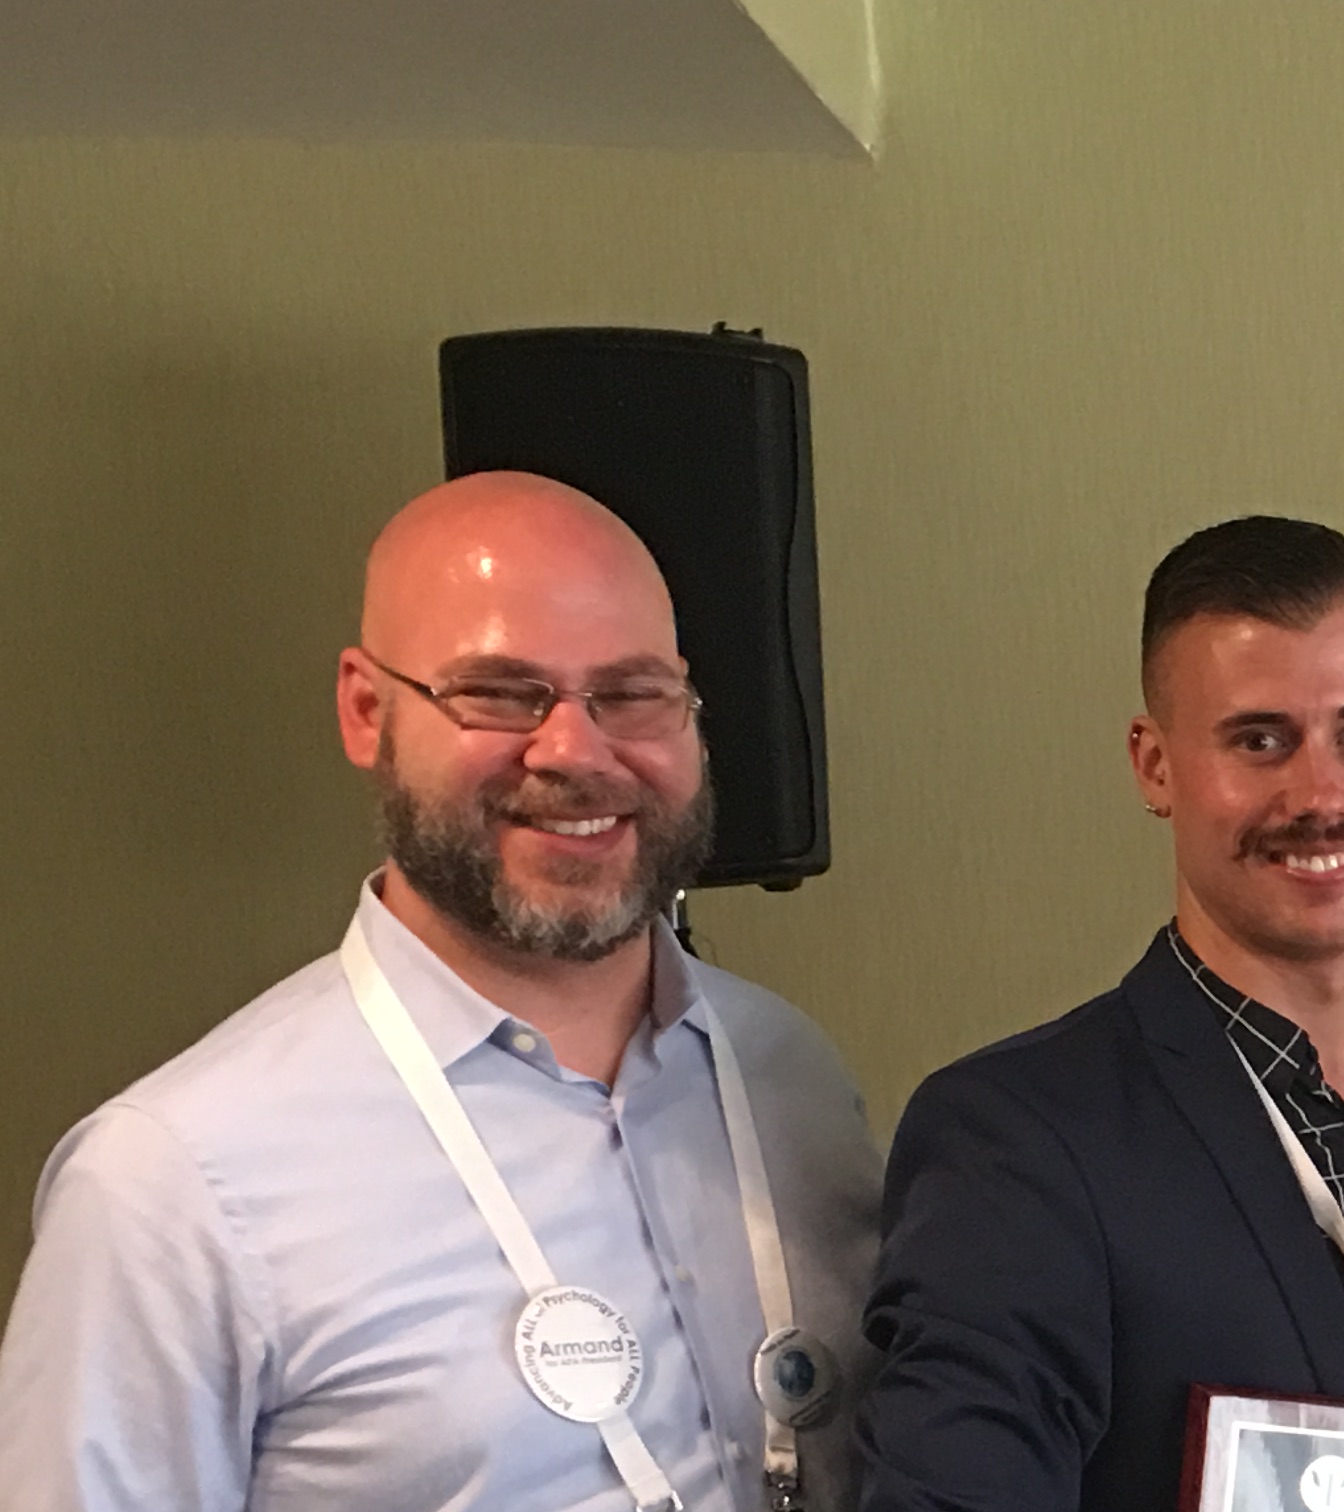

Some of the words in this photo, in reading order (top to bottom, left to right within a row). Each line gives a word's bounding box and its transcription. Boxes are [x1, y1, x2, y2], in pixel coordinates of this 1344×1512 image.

[542, 1290, 616, 1318] Psychology
[521, 1319, 538, 1341] All
[615, 1316, 630, 1335] for
[540, 1335, 624, 1358] Armand
[626, 1339, 640, 1361] All
[523, 1345, 573, 1411] Advancing
[613, 1365, 640, 1406] People
